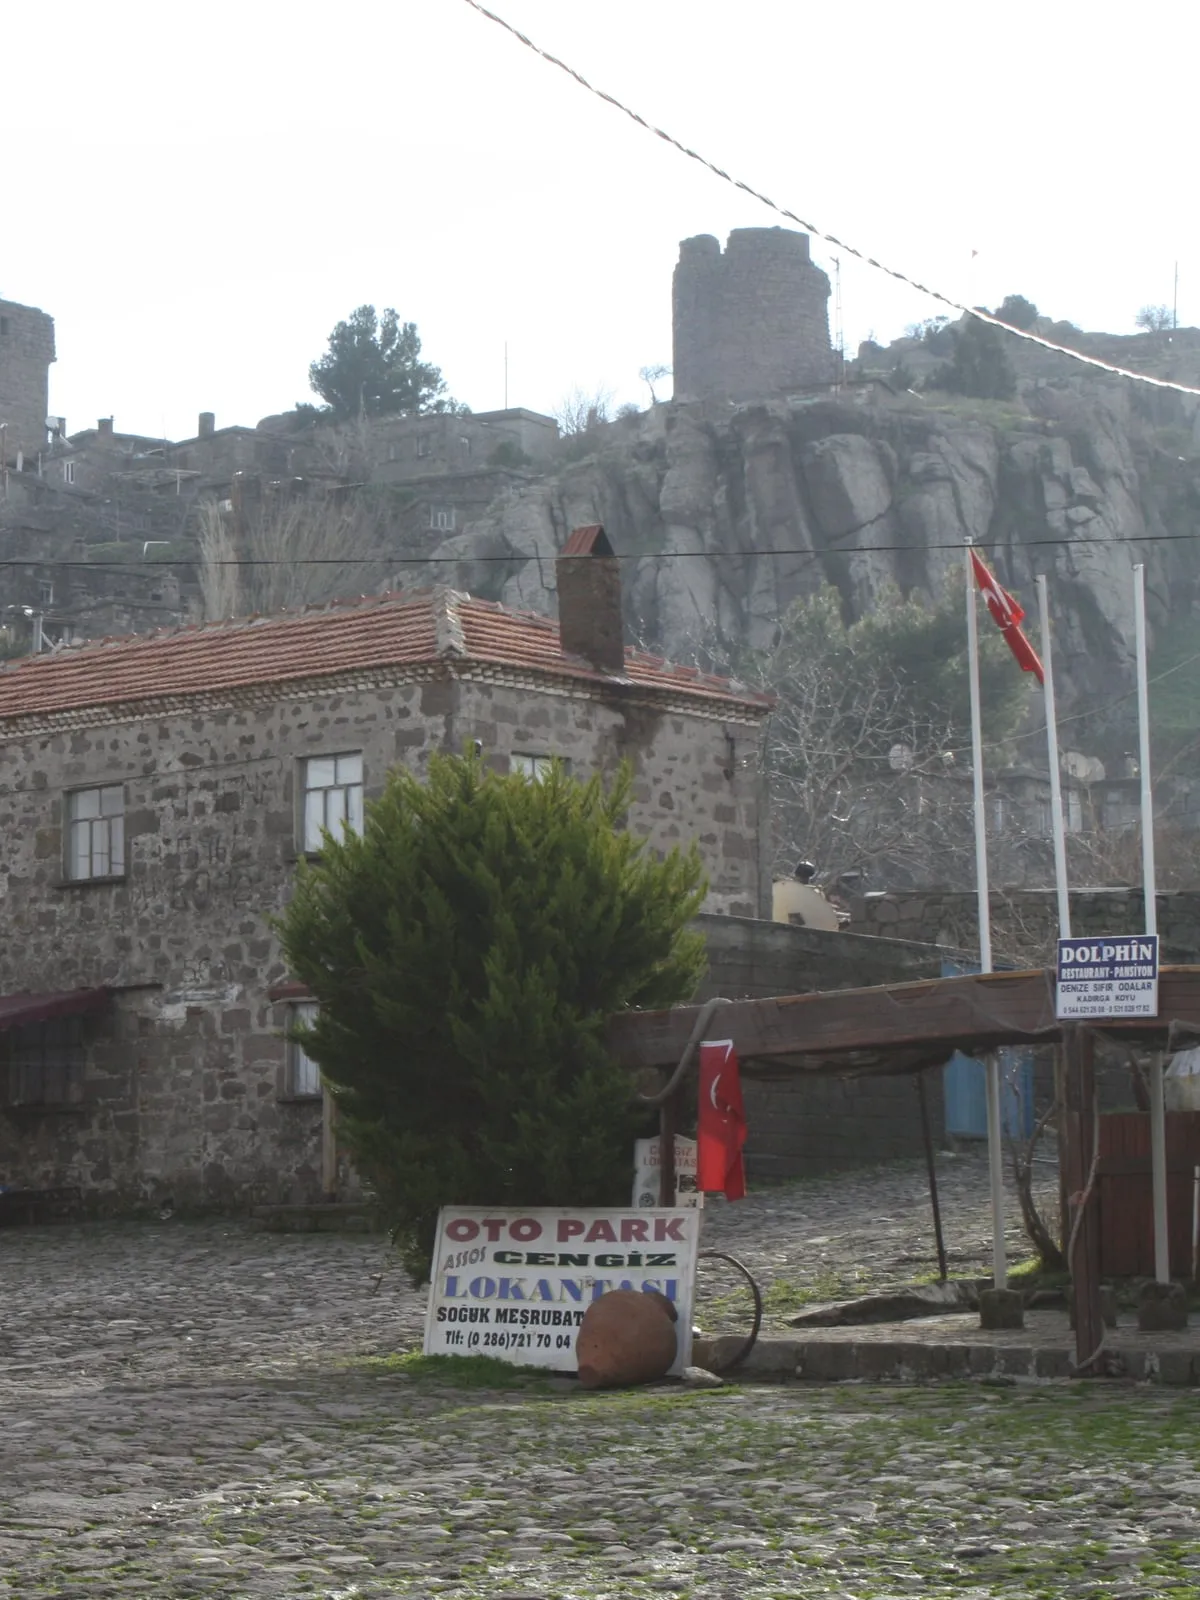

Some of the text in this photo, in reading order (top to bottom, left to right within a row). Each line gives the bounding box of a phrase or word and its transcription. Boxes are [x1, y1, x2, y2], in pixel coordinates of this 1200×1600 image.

[445, 1217, 687, 1243] OTO PARK
[443, 1246, 677, 1271] ASSOS CENGİZ
[436, 1304, 585, 1329] SOĞUK MEŞRUBAT
[536, 1332, 551, 1347] 70
[555, 1333, 571, 1348] 04
